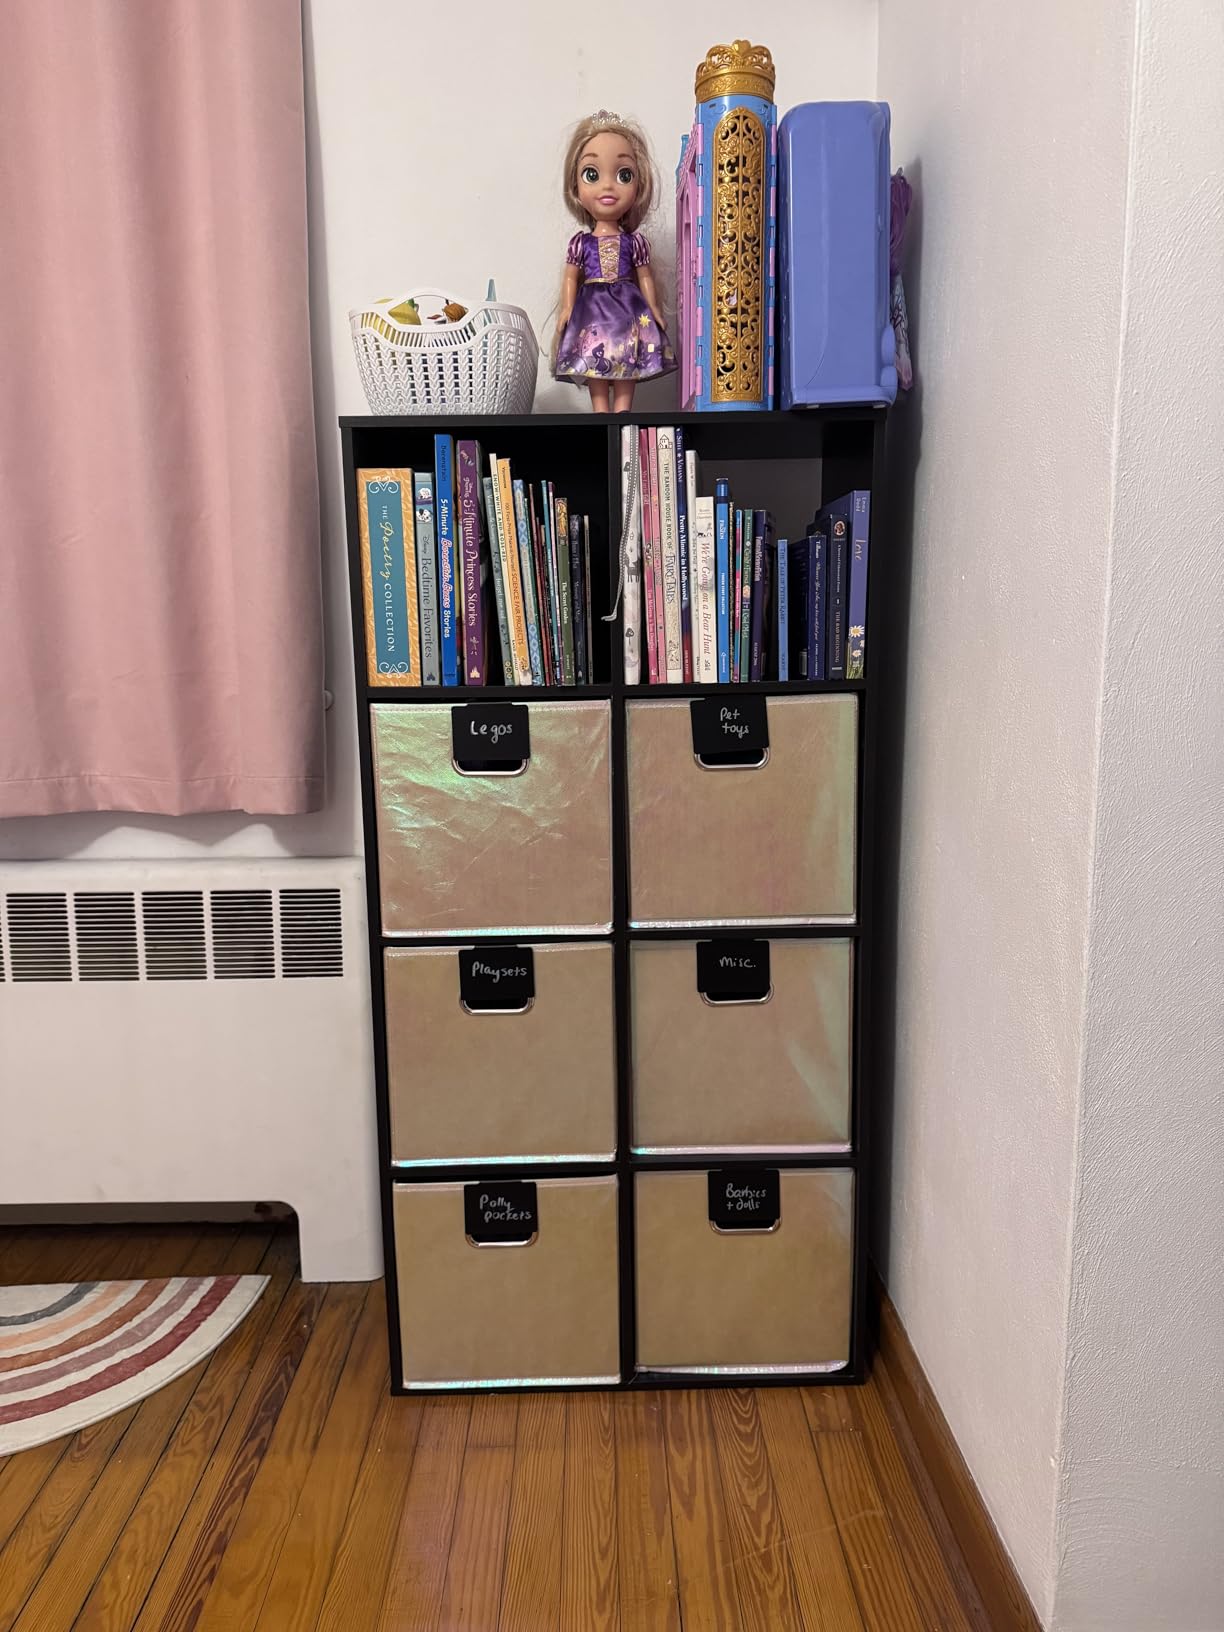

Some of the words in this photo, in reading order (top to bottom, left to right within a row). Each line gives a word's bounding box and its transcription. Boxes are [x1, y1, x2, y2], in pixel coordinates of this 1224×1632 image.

[440, 499, 449, 536] 5-Minute
[463, 499, 477, 547] 5-Minute
[379, 521, 396, 581] Poetry
[667, 541, 672, 549] OF
[701, 542, 710, 564] We're
[421, 558, 433, 604] Bedtime
[464, 549, 478, 591] Princess
[699, 566, 710, 591] Going
[680, 566, 688, 601] Hollywood
[467, 592, 480, 627] Stories
[511, 572, 519, 600] SCIENCE
[515, 615, 524, 645] PROJECTS
[702, 593, 708, 602] on
[384, 583, 396, 652] COLLECTION
[443, 609, 452, 638] Stories
[702, 612, 711, 631] Bear
[423, 608, 433, 659] Favorites
[703, 633, 712, 655] Hunt
[720, 707, 741, 721] Pet
[470, 720, 513, 744] Legos
[722, 722, 750, 739] toys
[472, 961, 528, 983] Playsets
[479, 1194, 515, 1213] Polly
[484, 1210, 532, 1223] pockets
